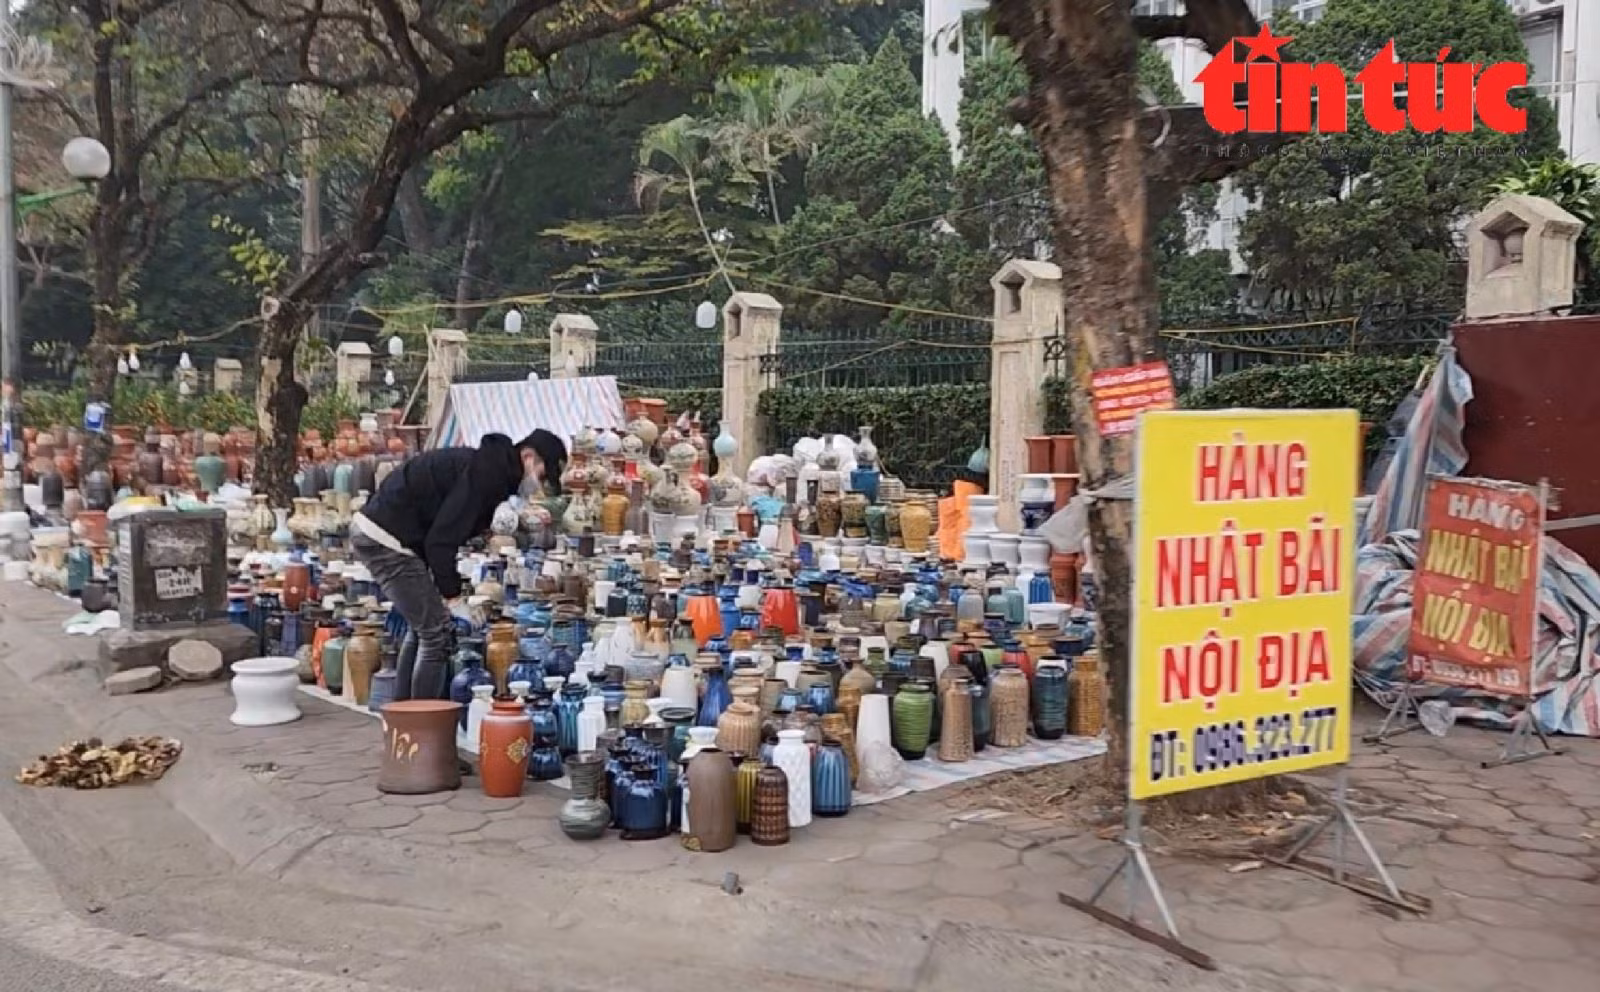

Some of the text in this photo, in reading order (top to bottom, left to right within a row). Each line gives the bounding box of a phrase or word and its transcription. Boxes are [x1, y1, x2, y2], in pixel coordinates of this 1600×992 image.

[1197, 431, 1307, 501] HÀNG
[1155, 516, 1340, 618] NHẬT BÃI
[1161, 629, 1330, 709] NỘI ĐỊA
